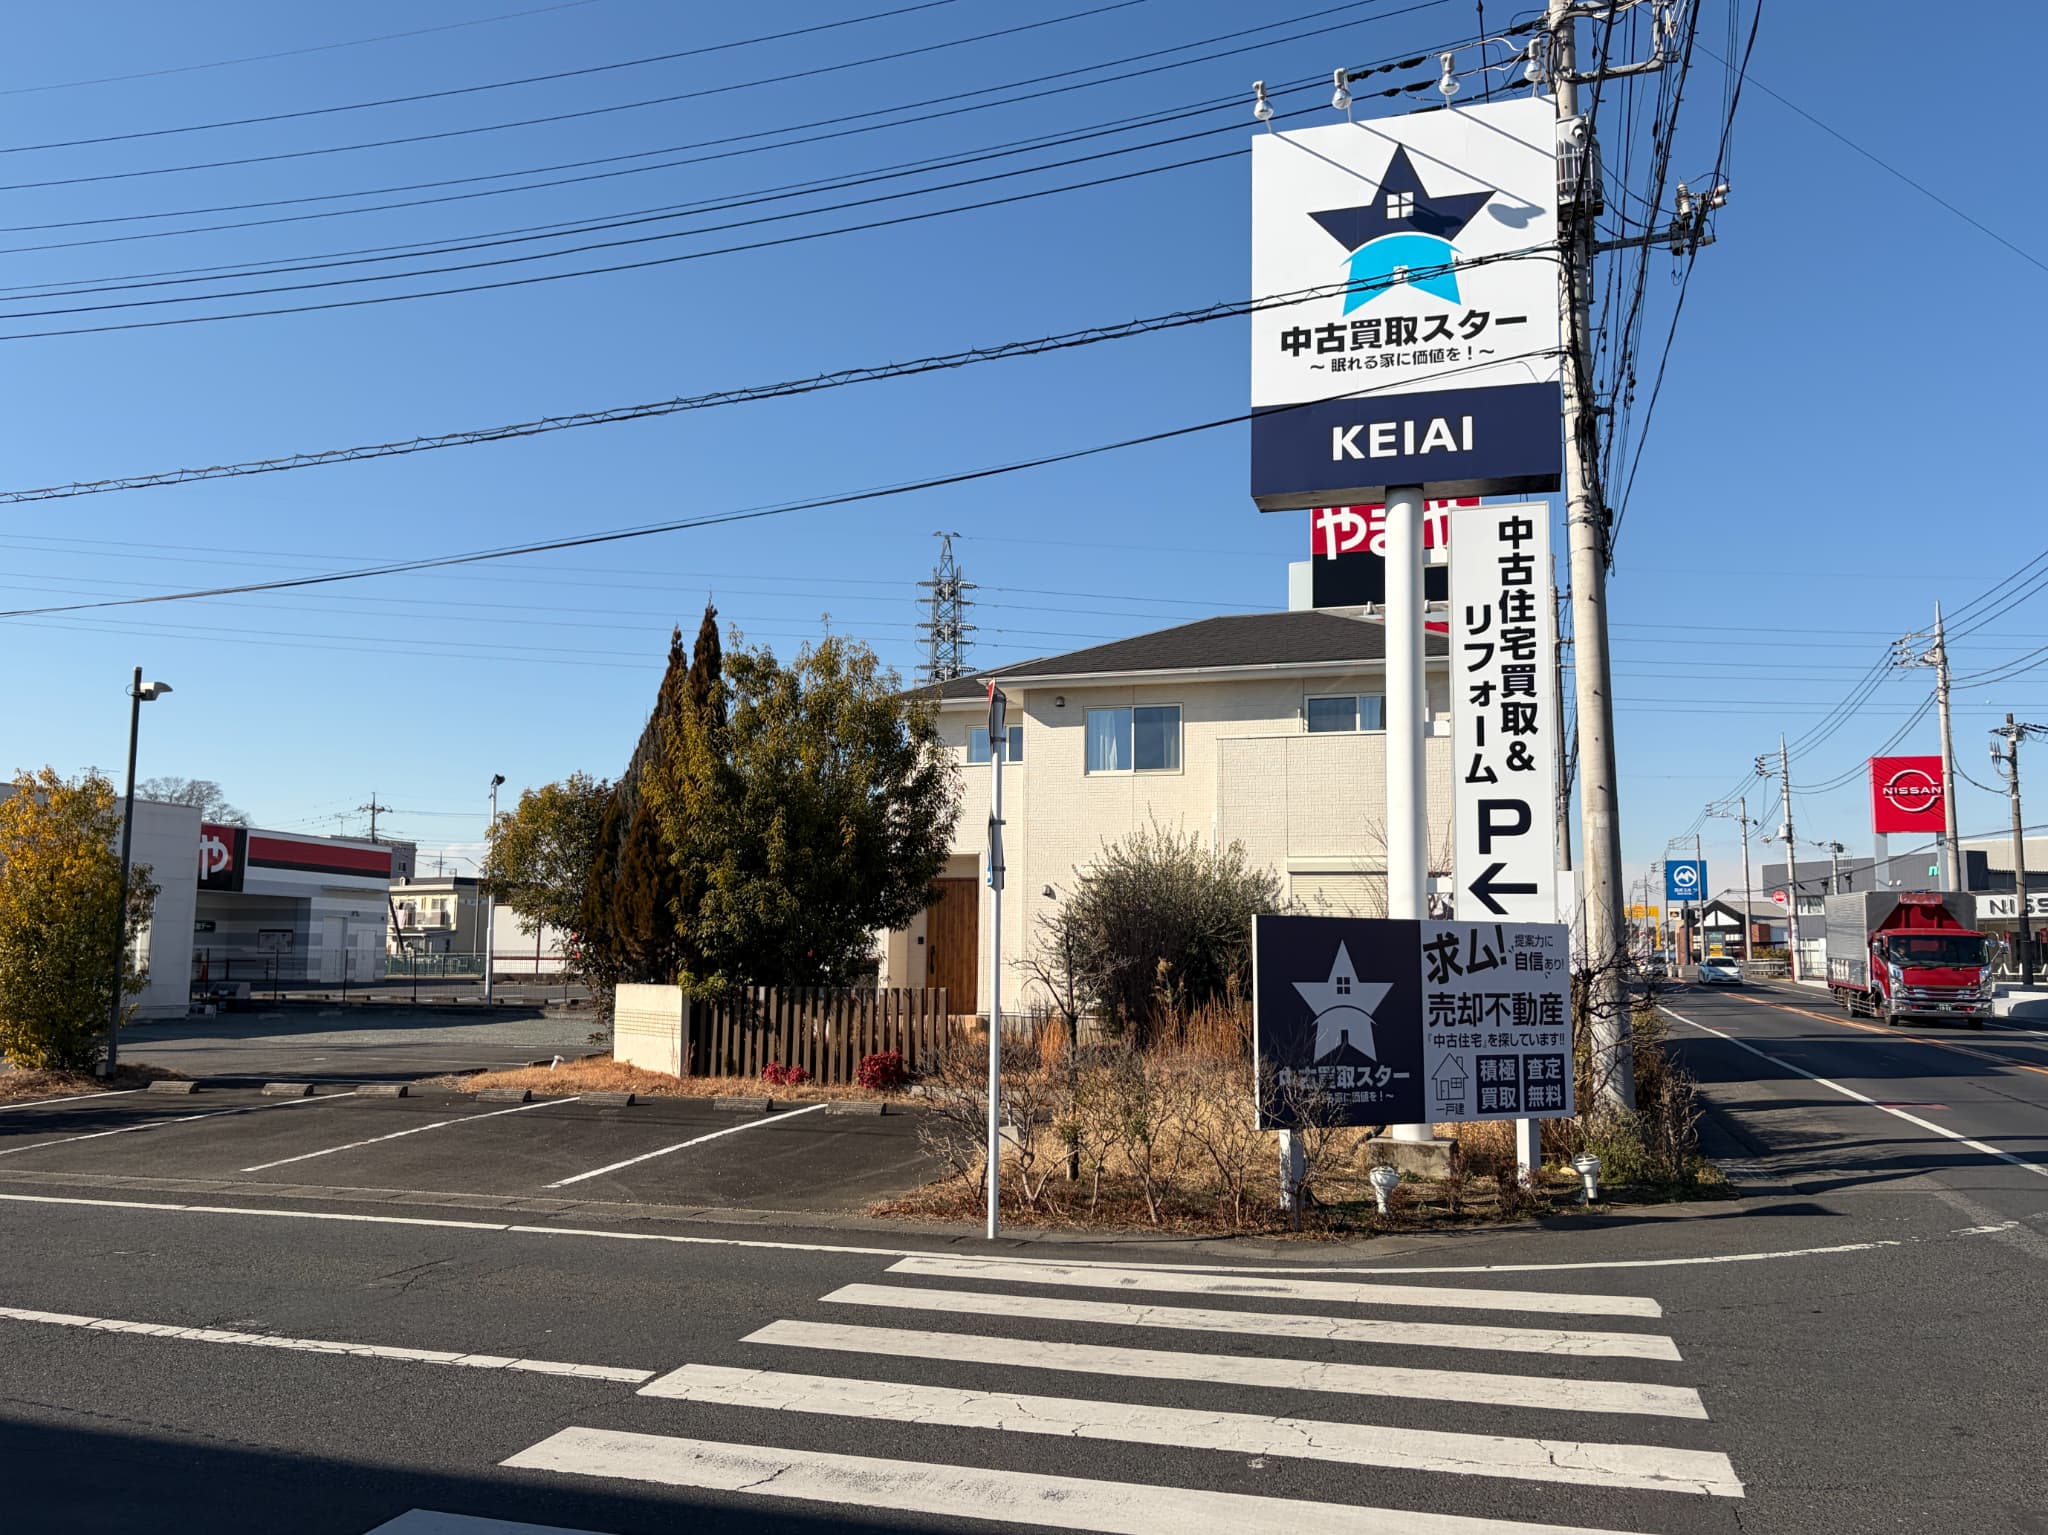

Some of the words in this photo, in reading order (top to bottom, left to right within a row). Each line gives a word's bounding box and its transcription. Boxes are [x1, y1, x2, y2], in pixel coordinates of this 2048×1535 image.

[1280, 309, 1528, 357] 中古買取スター
[1332, 415, 1473, 462] KEIAI
[1498, 515, 1539, 772] 中古住宅買取&
[1464, 604, 1498, 785] リフォーム
[1882, 786, 1942, 795] NISSAN
[1478, 799, 1532, 855] P
[1422, 924, 1507, 985] 求ム!
[1428, 992, 1564, 1027] 売却不動産
[1480, 1059, 1516, 1082] 積極
[1527, 1057, 1562, 1080] 査定
[1481, 1086, 1517, 1110] 買取
[1527, 1084, 1562, 1108] 無料
